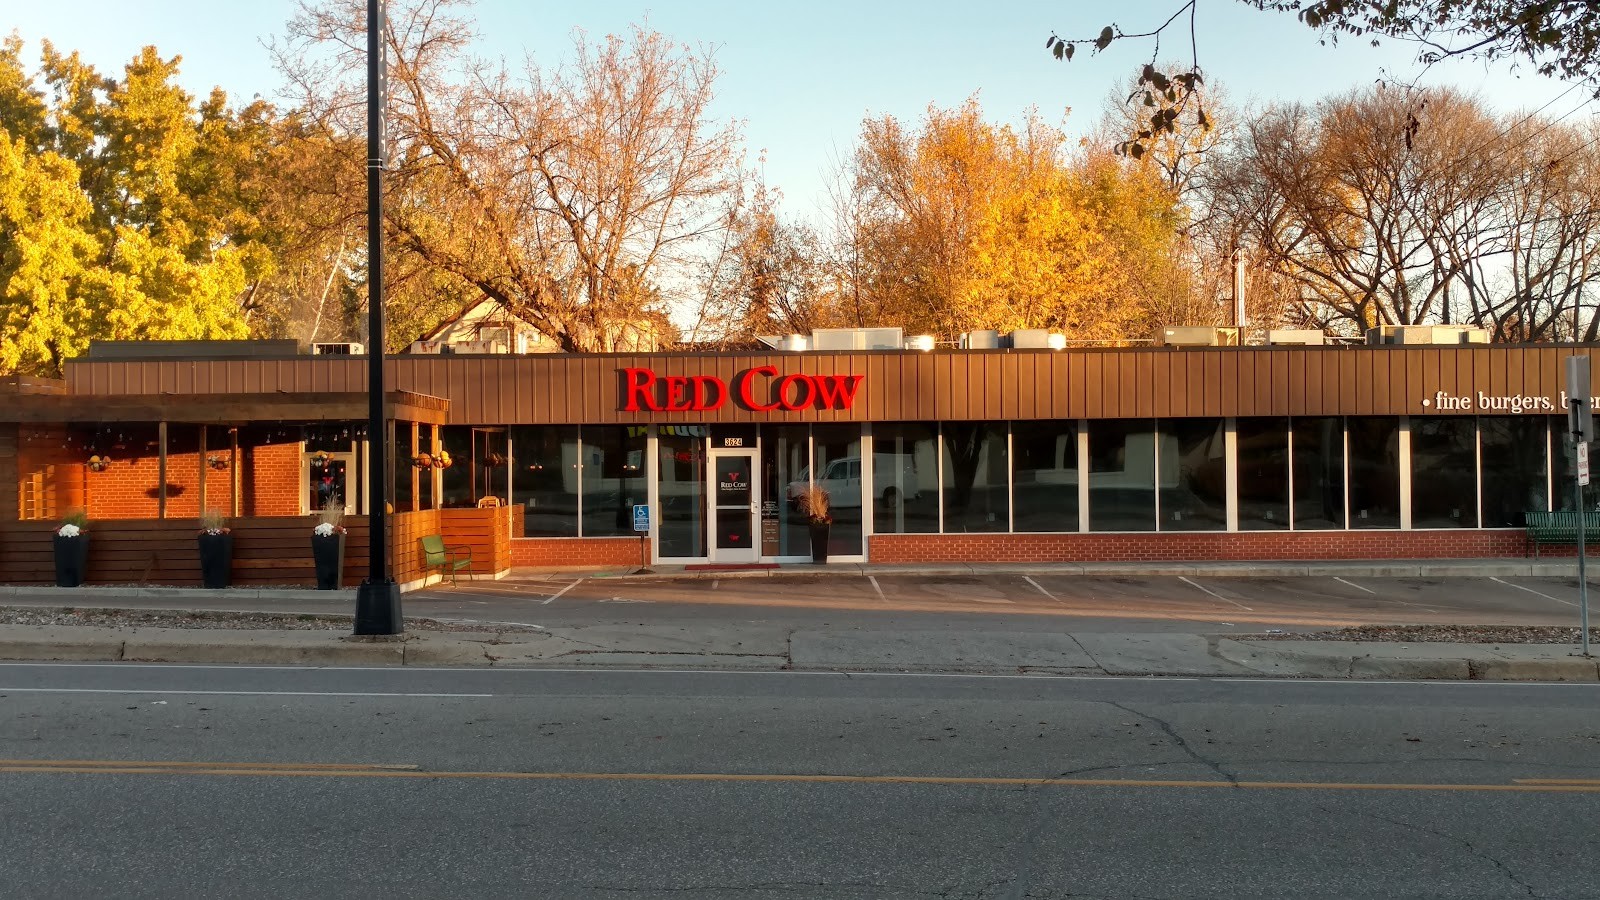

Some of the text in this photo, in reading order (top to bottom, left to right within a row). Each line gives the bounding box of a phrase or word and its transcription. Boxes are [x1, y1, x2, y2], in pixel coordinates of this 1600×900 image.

[624, 365, 864, 412] RED COW
[1436, 391, 1471, 410] fine
[1478, 391, 1555, 414] burgers,
[725, 438, 742, 446] 3624
